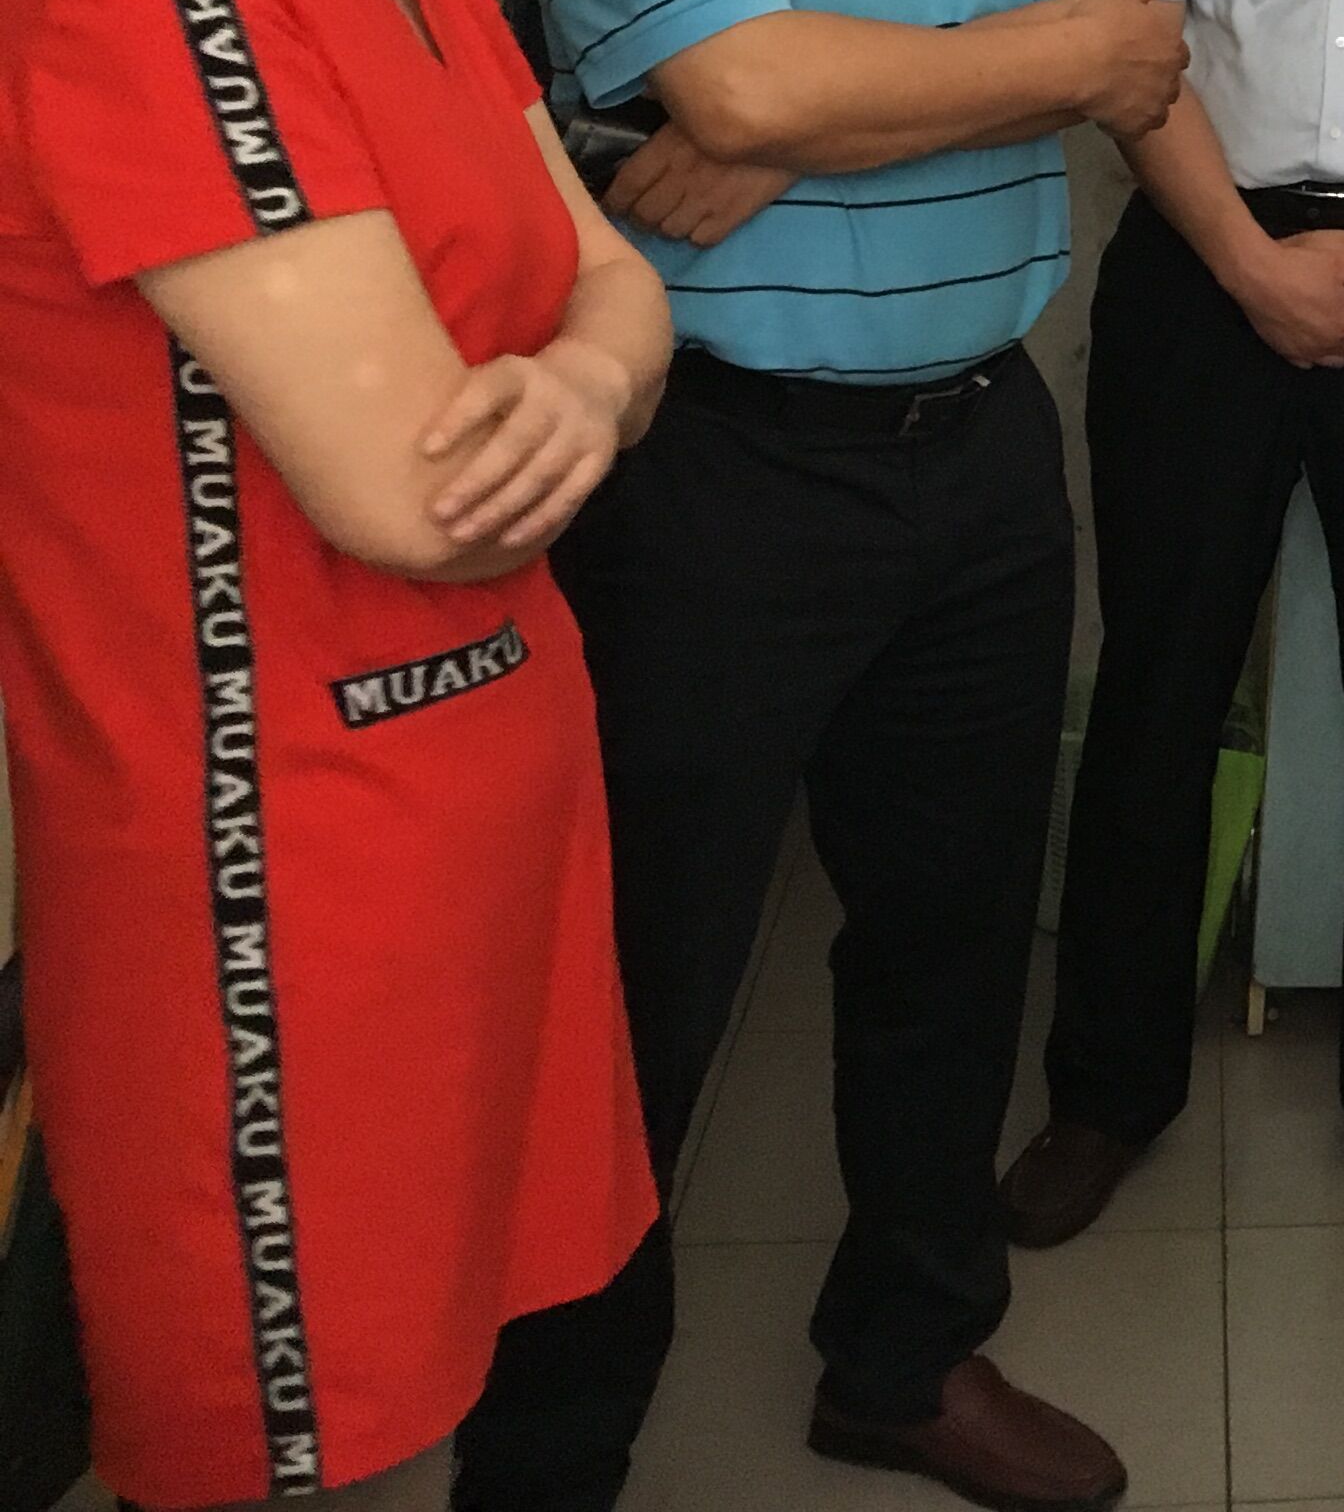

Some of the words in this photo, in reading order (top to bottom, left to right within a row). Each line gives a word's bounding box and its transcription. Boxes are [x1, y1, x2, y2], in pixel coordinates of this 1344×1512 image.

[183, 417, 247, 649] MUAKU
[206, 670, 262, 900] MUAKU
[342, 624, 525, 722] MUAKU
[223, 922, 282, 1158] MUAKU
[243, 1178, 308, 1414] MUAKU
